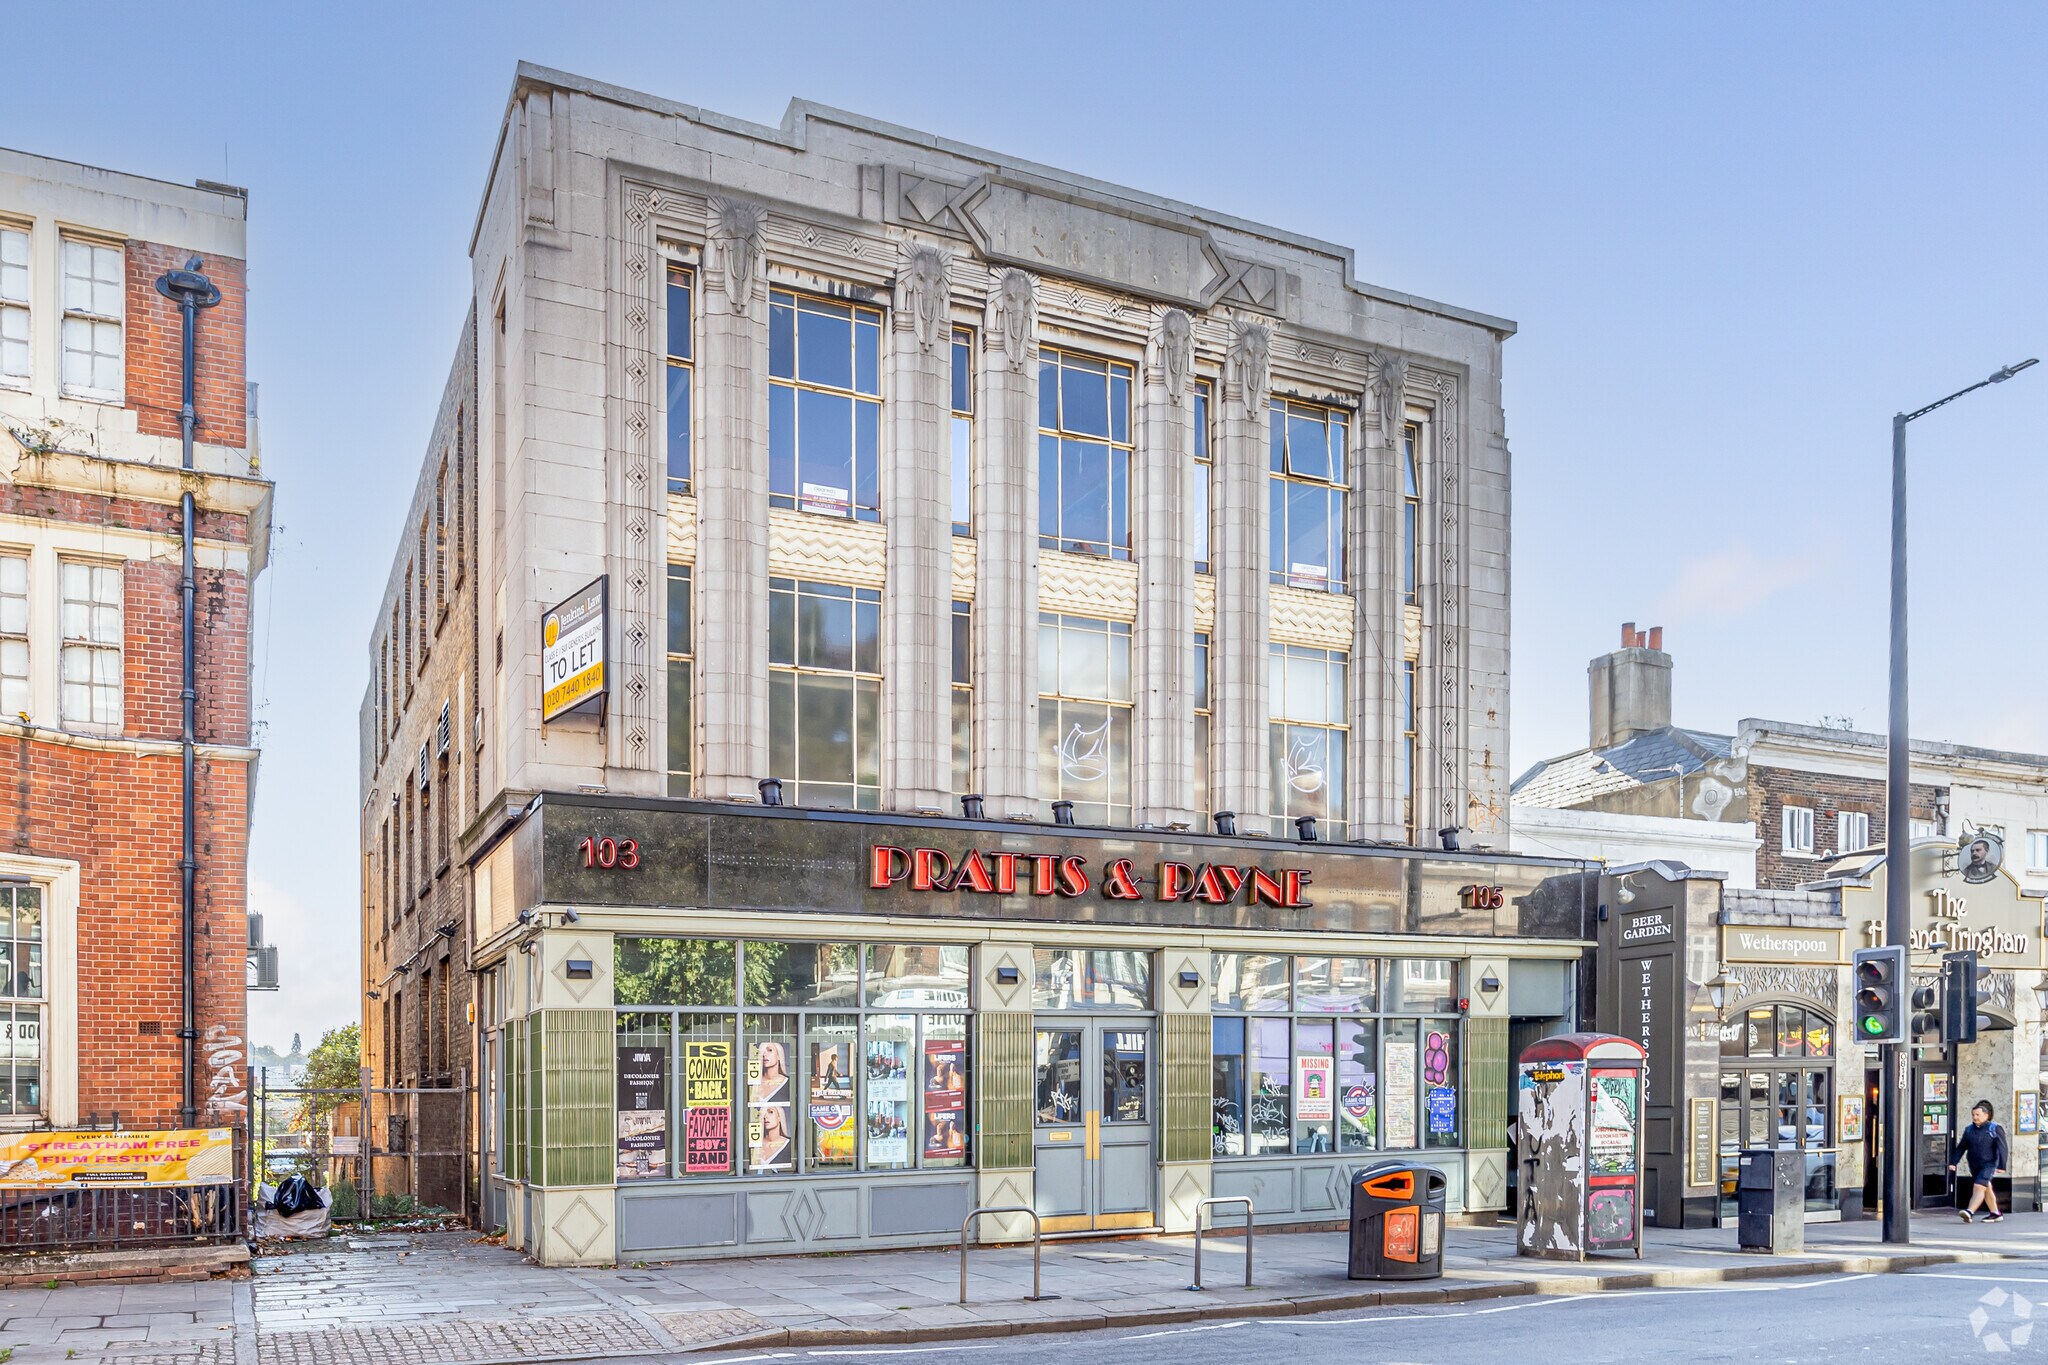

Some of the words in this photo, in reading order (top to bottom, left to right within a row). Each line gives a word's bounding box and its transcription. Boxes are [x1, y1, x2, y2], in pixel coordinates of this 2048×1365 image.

[560, 604, 585, 633] Jenkins
[587, 593, 601, 610] Law
[550, 657, 567, 683] TO
[572, 638, 596, 672] LET
[547, 690, 560, 708] 020
[562, 678, 580, 700] 7440
[582, 667, 601, 689] 1840
[578, 836, 640, 870] 103
[871, 844, 1090, 897] PRATTS
[1105, 857, 1144, 900] &
[1157, 861, 1314, 908] PAYNE
[1465, 884, 1504, 910] 105
[1932, 888, 1968, 919] The
[1632, 914, 1663, 928] BEER
[1623, 924, 1671, 940] GARDEN
[1946, 922, 2029, 958] Tringham
[1739, 932, 1827, 956] Wetherspoon
[689, 1045, 727, 1057] IS
[689, 1059, 727, 1079] COMING
[1301, 1058, 1329, 1069] MISSING
[1533, 1071, 1564, 1082] Telephon
[694, 1081, 723, 1099] BACK
[689, 1116, 727, 1137] FAVORITE
[28, 1141, 148, 1151] STREATHAM
[155, 1139, 200, 1148] FREE
[696, 1139, 720, 1150] BOY
[43, 1155, 88, 1163] FILM
[95, 1154, 187, 1163] FESTIVAL
[689, 1152, 727, 1164] BAND
